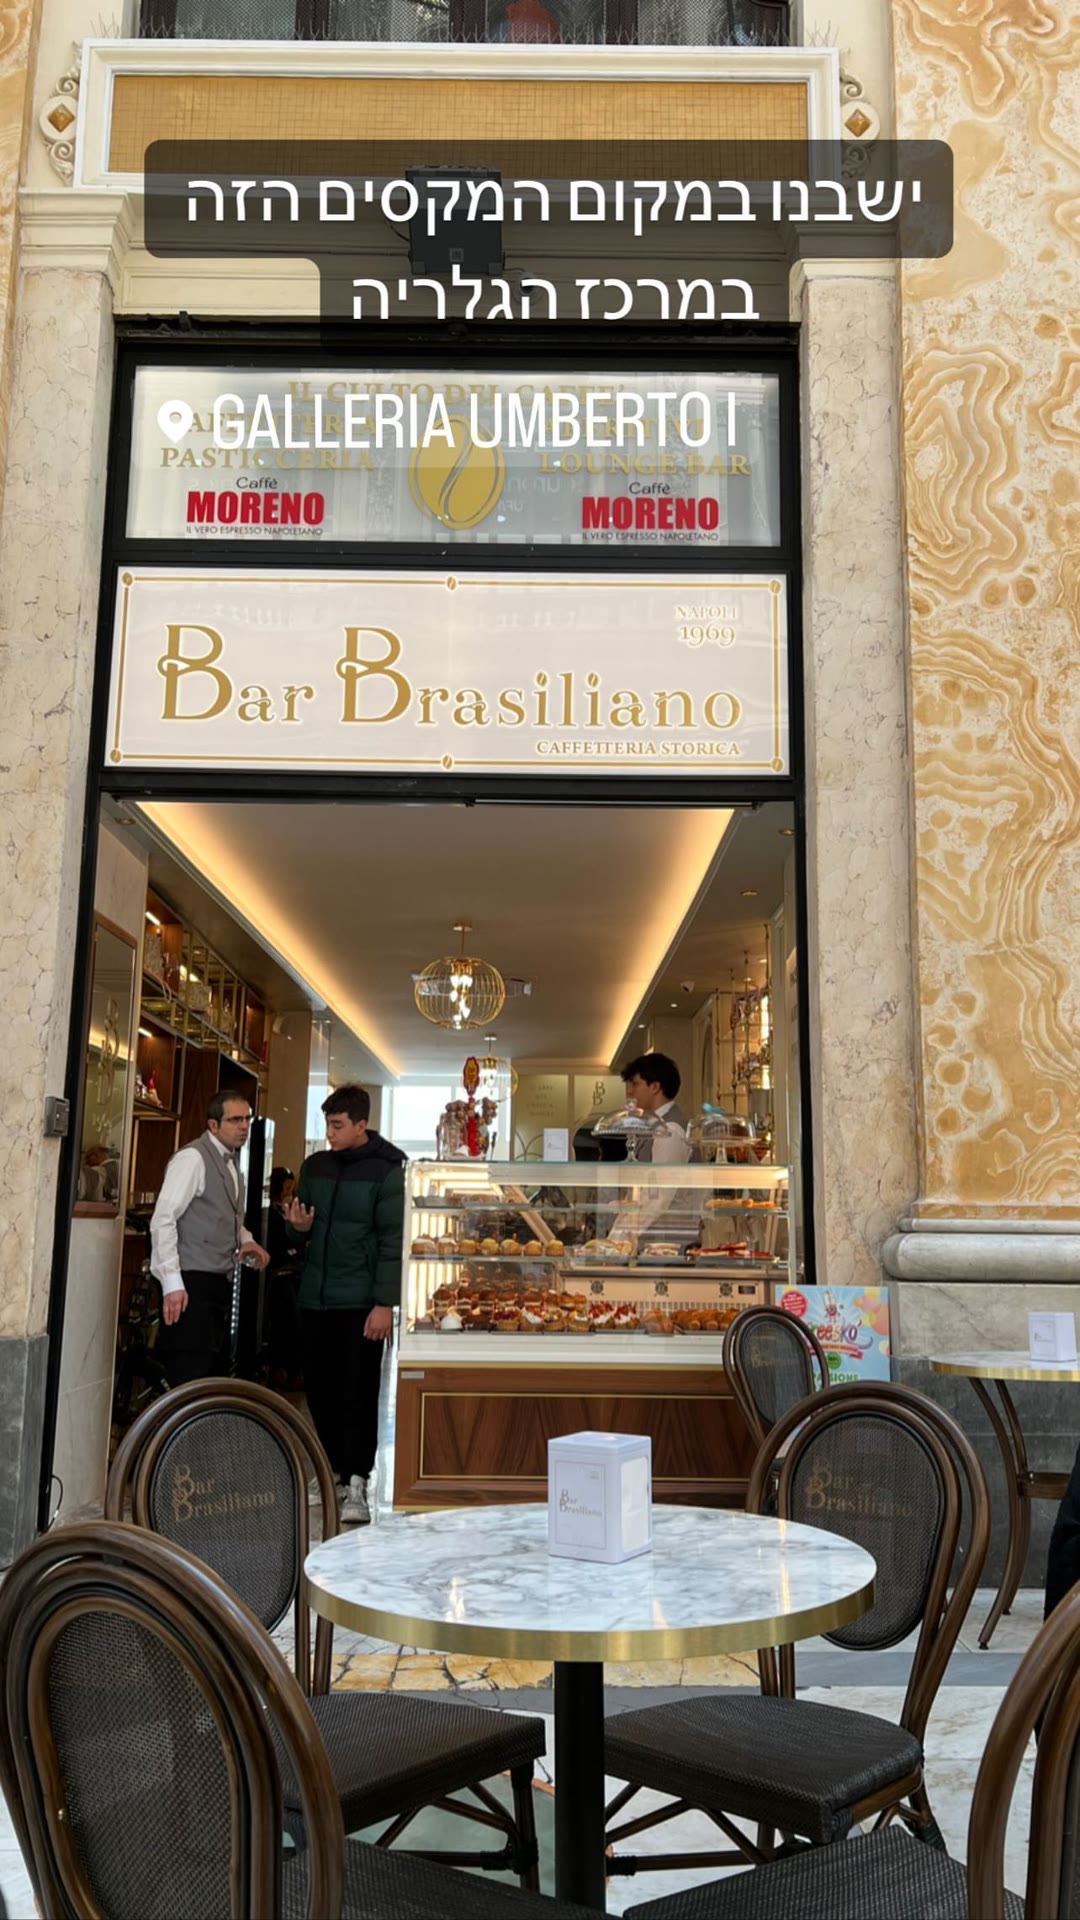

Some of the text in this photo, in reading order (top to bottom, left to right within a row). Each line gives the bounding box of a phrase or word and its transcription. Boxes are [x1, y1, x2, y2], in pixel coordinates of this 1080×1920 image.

[160, 446, 374, 472] PASTICCERIA
[539, 452, 752, 476] LOUNGE BAR
[236, 476, 278, 490] Caffè
[628, 481, 671, 495] Caffè
[186, 491, 325, 525] MORENO
[582, 496, 719, 530] MORENO
[195, 526, 218, 534] VERO
[220, 526, 262, 535] ESPRESSO
[264, 526, 323, 536] NAPOLETANO
[590, 532, 614, 541] VERO
[616, 532, 658, 541] ESPRESSO
[660, 532, 719, 542] NAPOLETANO
[676, 606, 737, 619] NAPOLI
[680, 622, 736, 647] 1969
[157, 624, 741, 729] Bar Brasiliano
[536, 740, 740, 756] CAFFETTERIA STORICA
[173, 1464, 215, 1497] Bar
